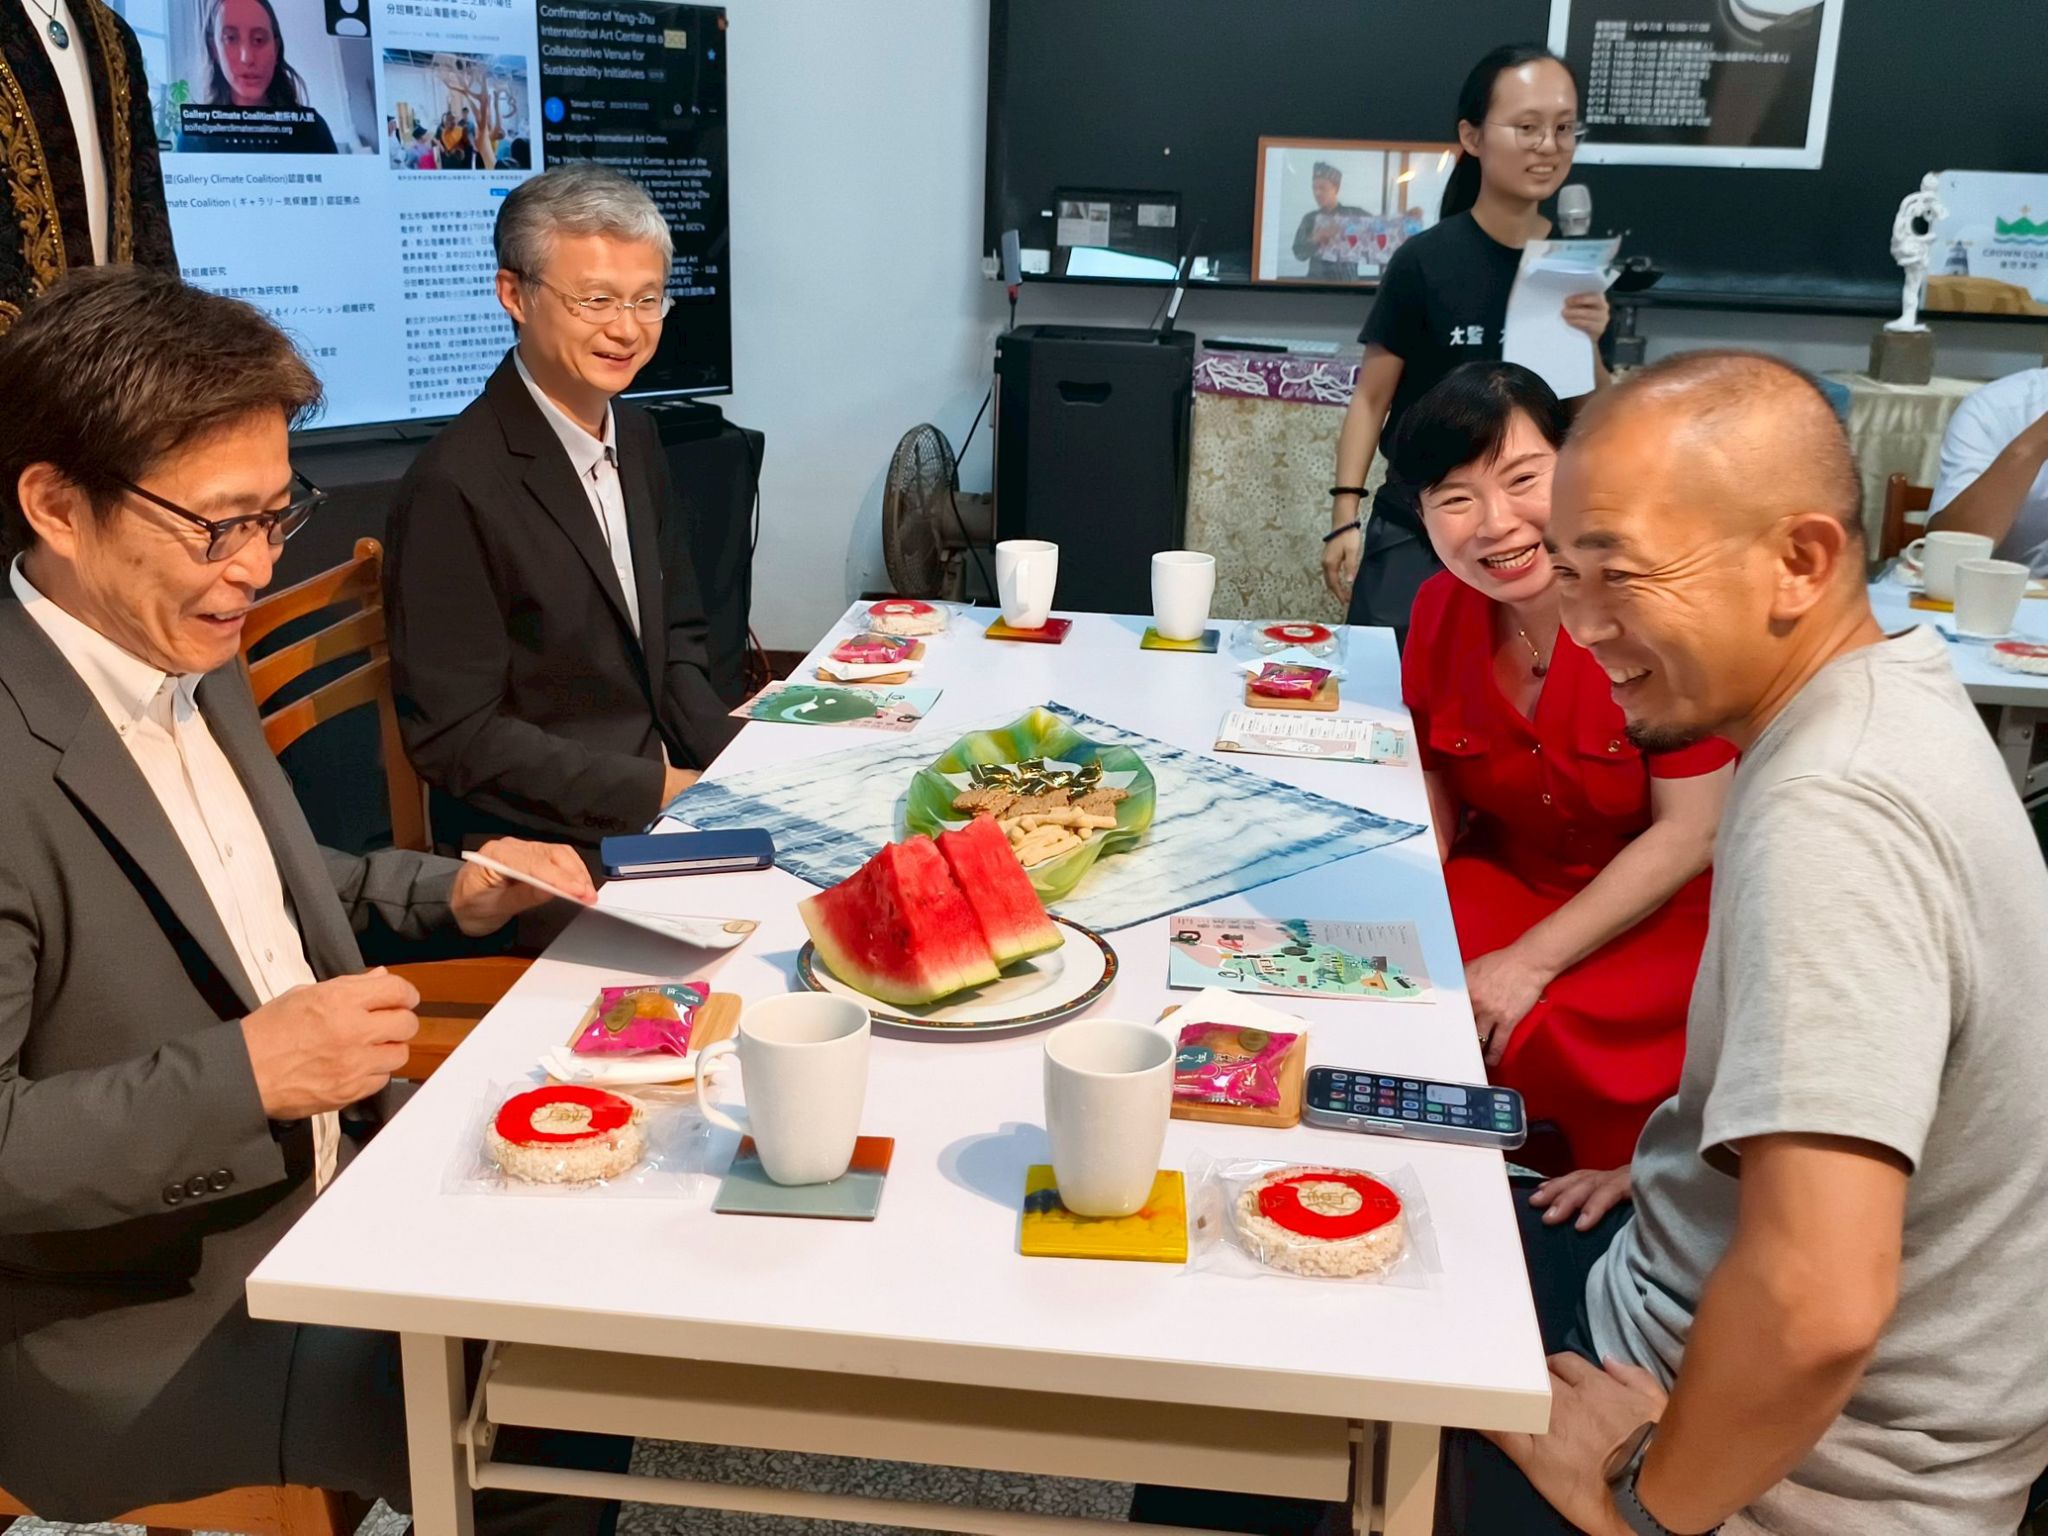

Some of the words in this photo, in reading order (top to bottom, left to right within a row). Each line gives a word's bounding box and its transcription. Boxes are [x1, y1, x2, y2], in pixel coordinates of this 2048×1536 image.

[540, 4, 600, 21] Confirmation
[602, 9, 612, 21] of
[614, 11, 656, 26] Yang-Zhu
[541, 25, 598, 40] International
[600, 29, 614, 41] Art
[616, 31, 644, 43] Center
[542, 44, 602, 59] Collaborative
[603, 48, 631, 60] Venue
[632, 49, 645, 61] for
[543, 63, 602, 80] Sustainability
[604, 66, 645, 80] Initiatives
[183, 110, 210, 121] Gallery
[212, 110, 240, 120] Climate
[210, 174, 244, 184] Climate
[190, 198, 231, 207] Coalition
[1982, 249, 2021, 257] CROWN
